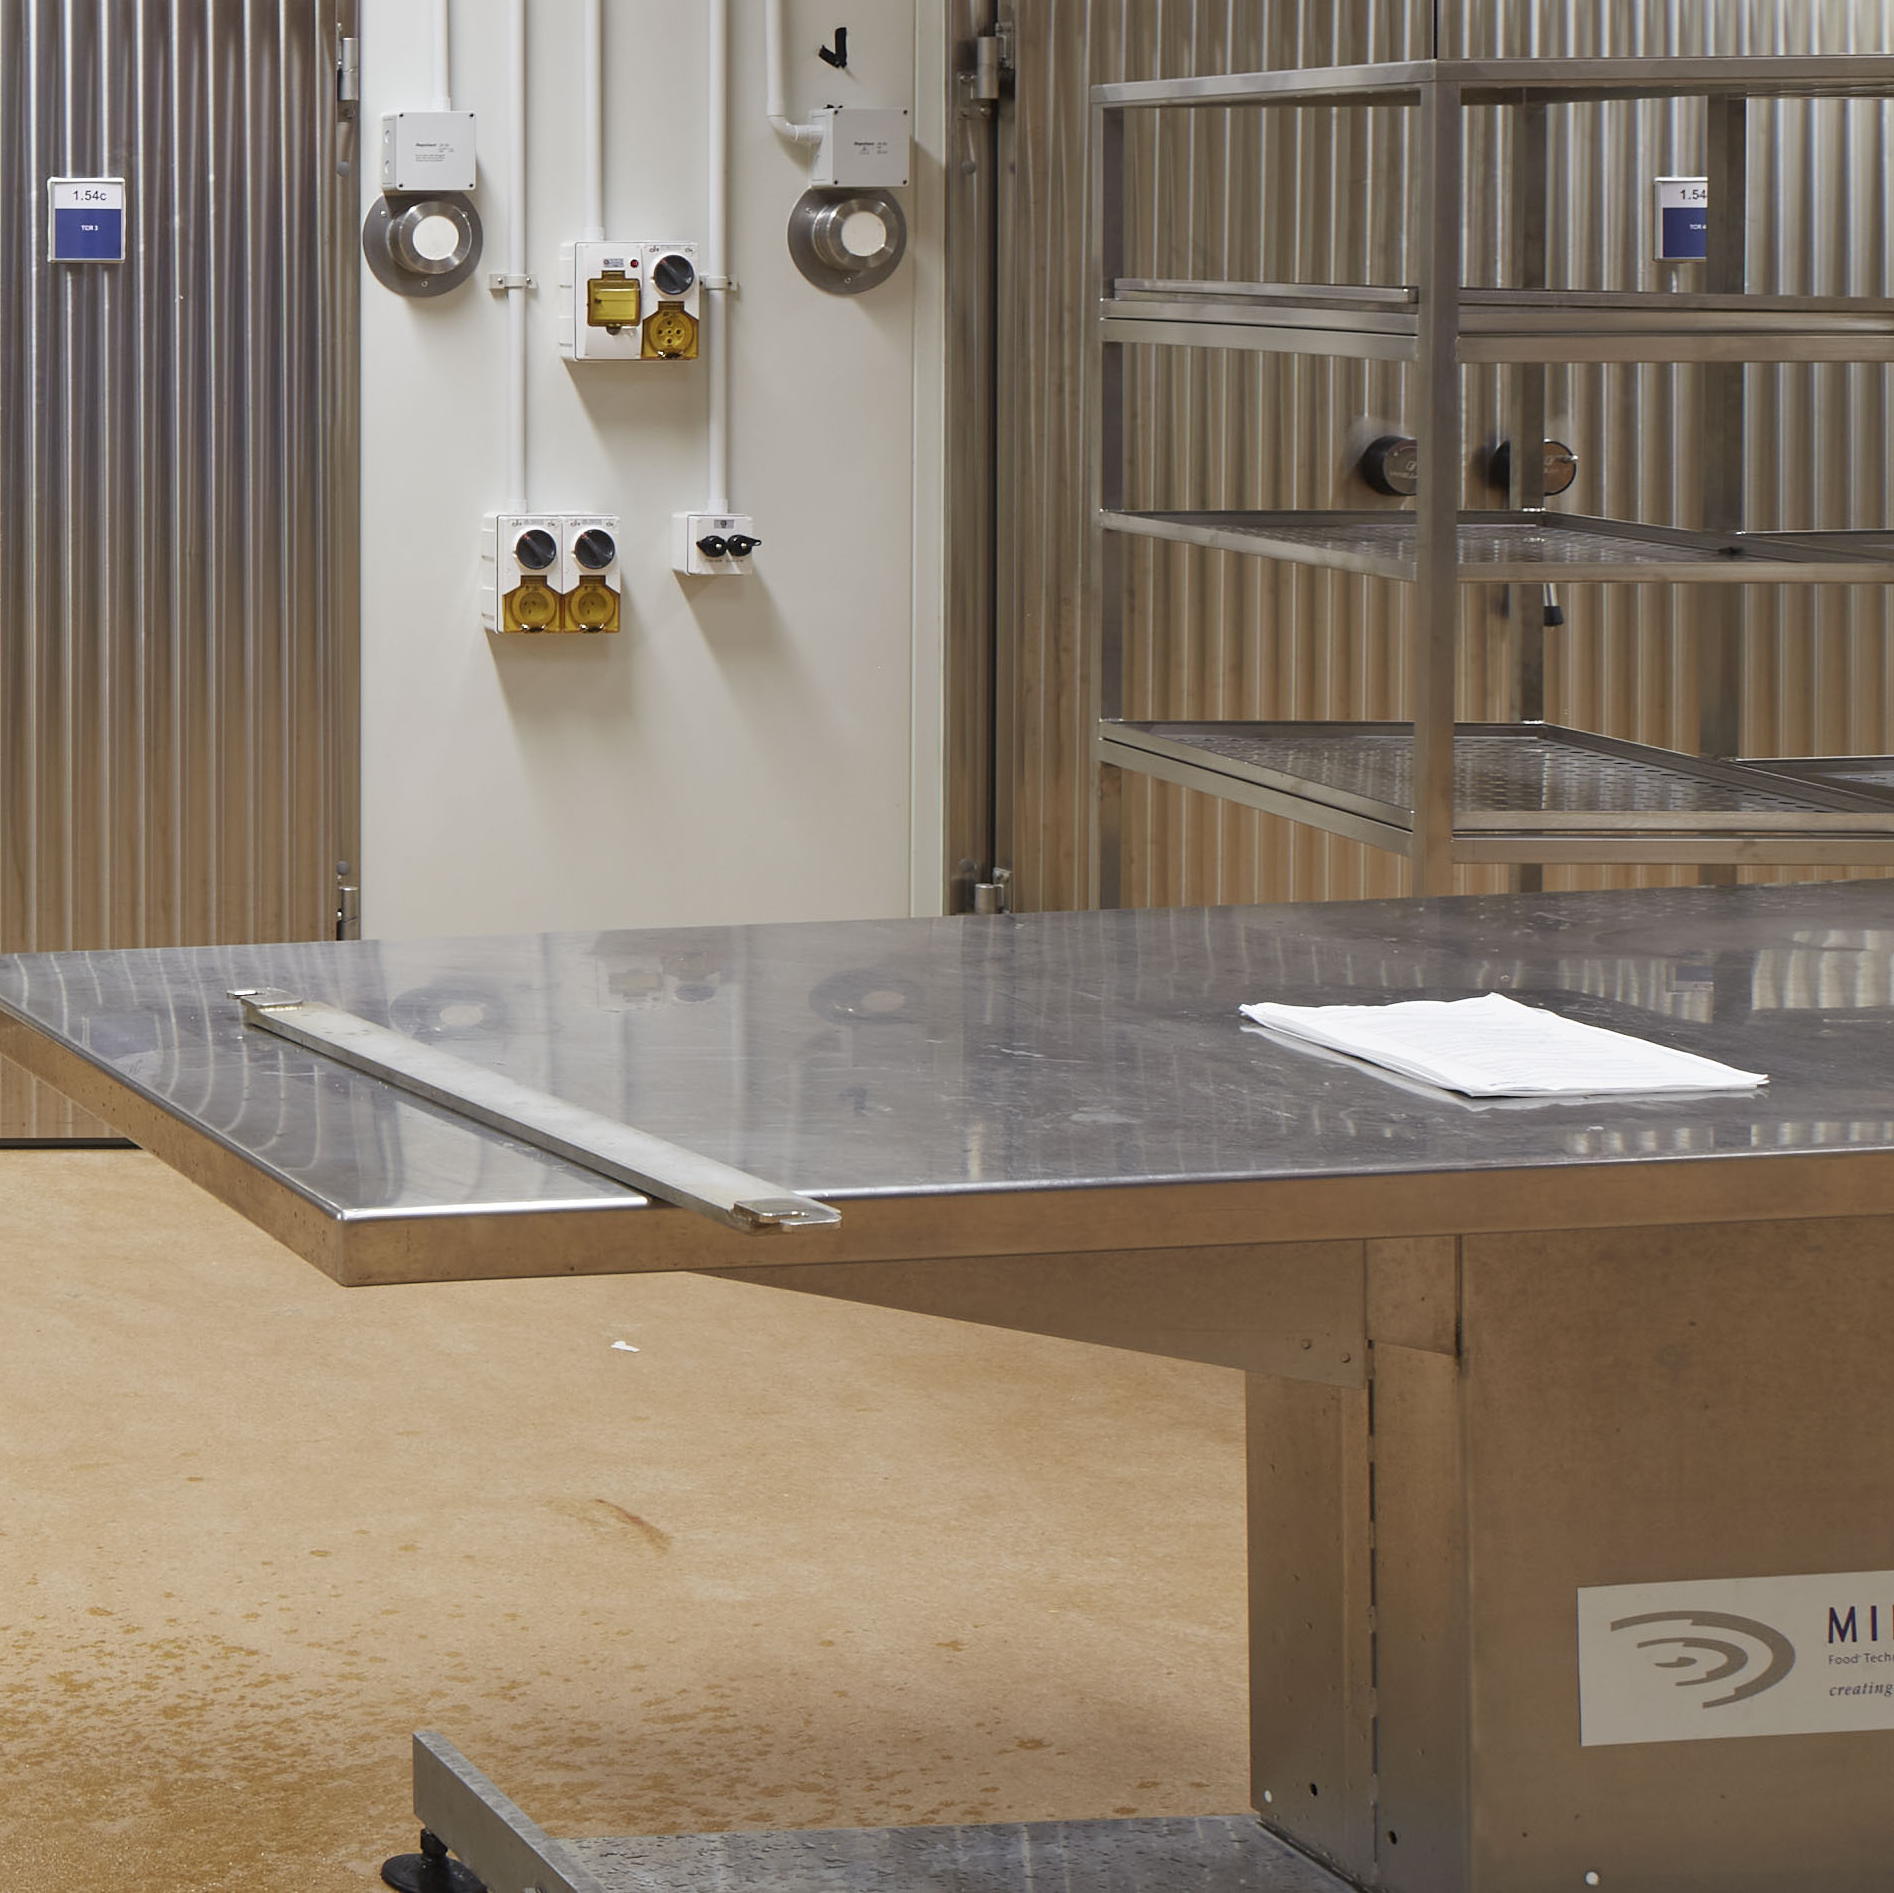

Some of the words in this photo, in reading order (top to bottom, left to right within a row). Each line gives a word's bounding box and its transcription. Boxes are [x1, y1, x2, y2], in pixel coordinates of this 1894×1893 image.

[72, 190, 107, 201] 1.54c
[1828, 1604, 1894, 1644] MI
[1828, 1654, 1860, 1665] Food
[1863, 1652, 1894, 1663] Tech
[1828, 1682, 1894, 1698] creating
